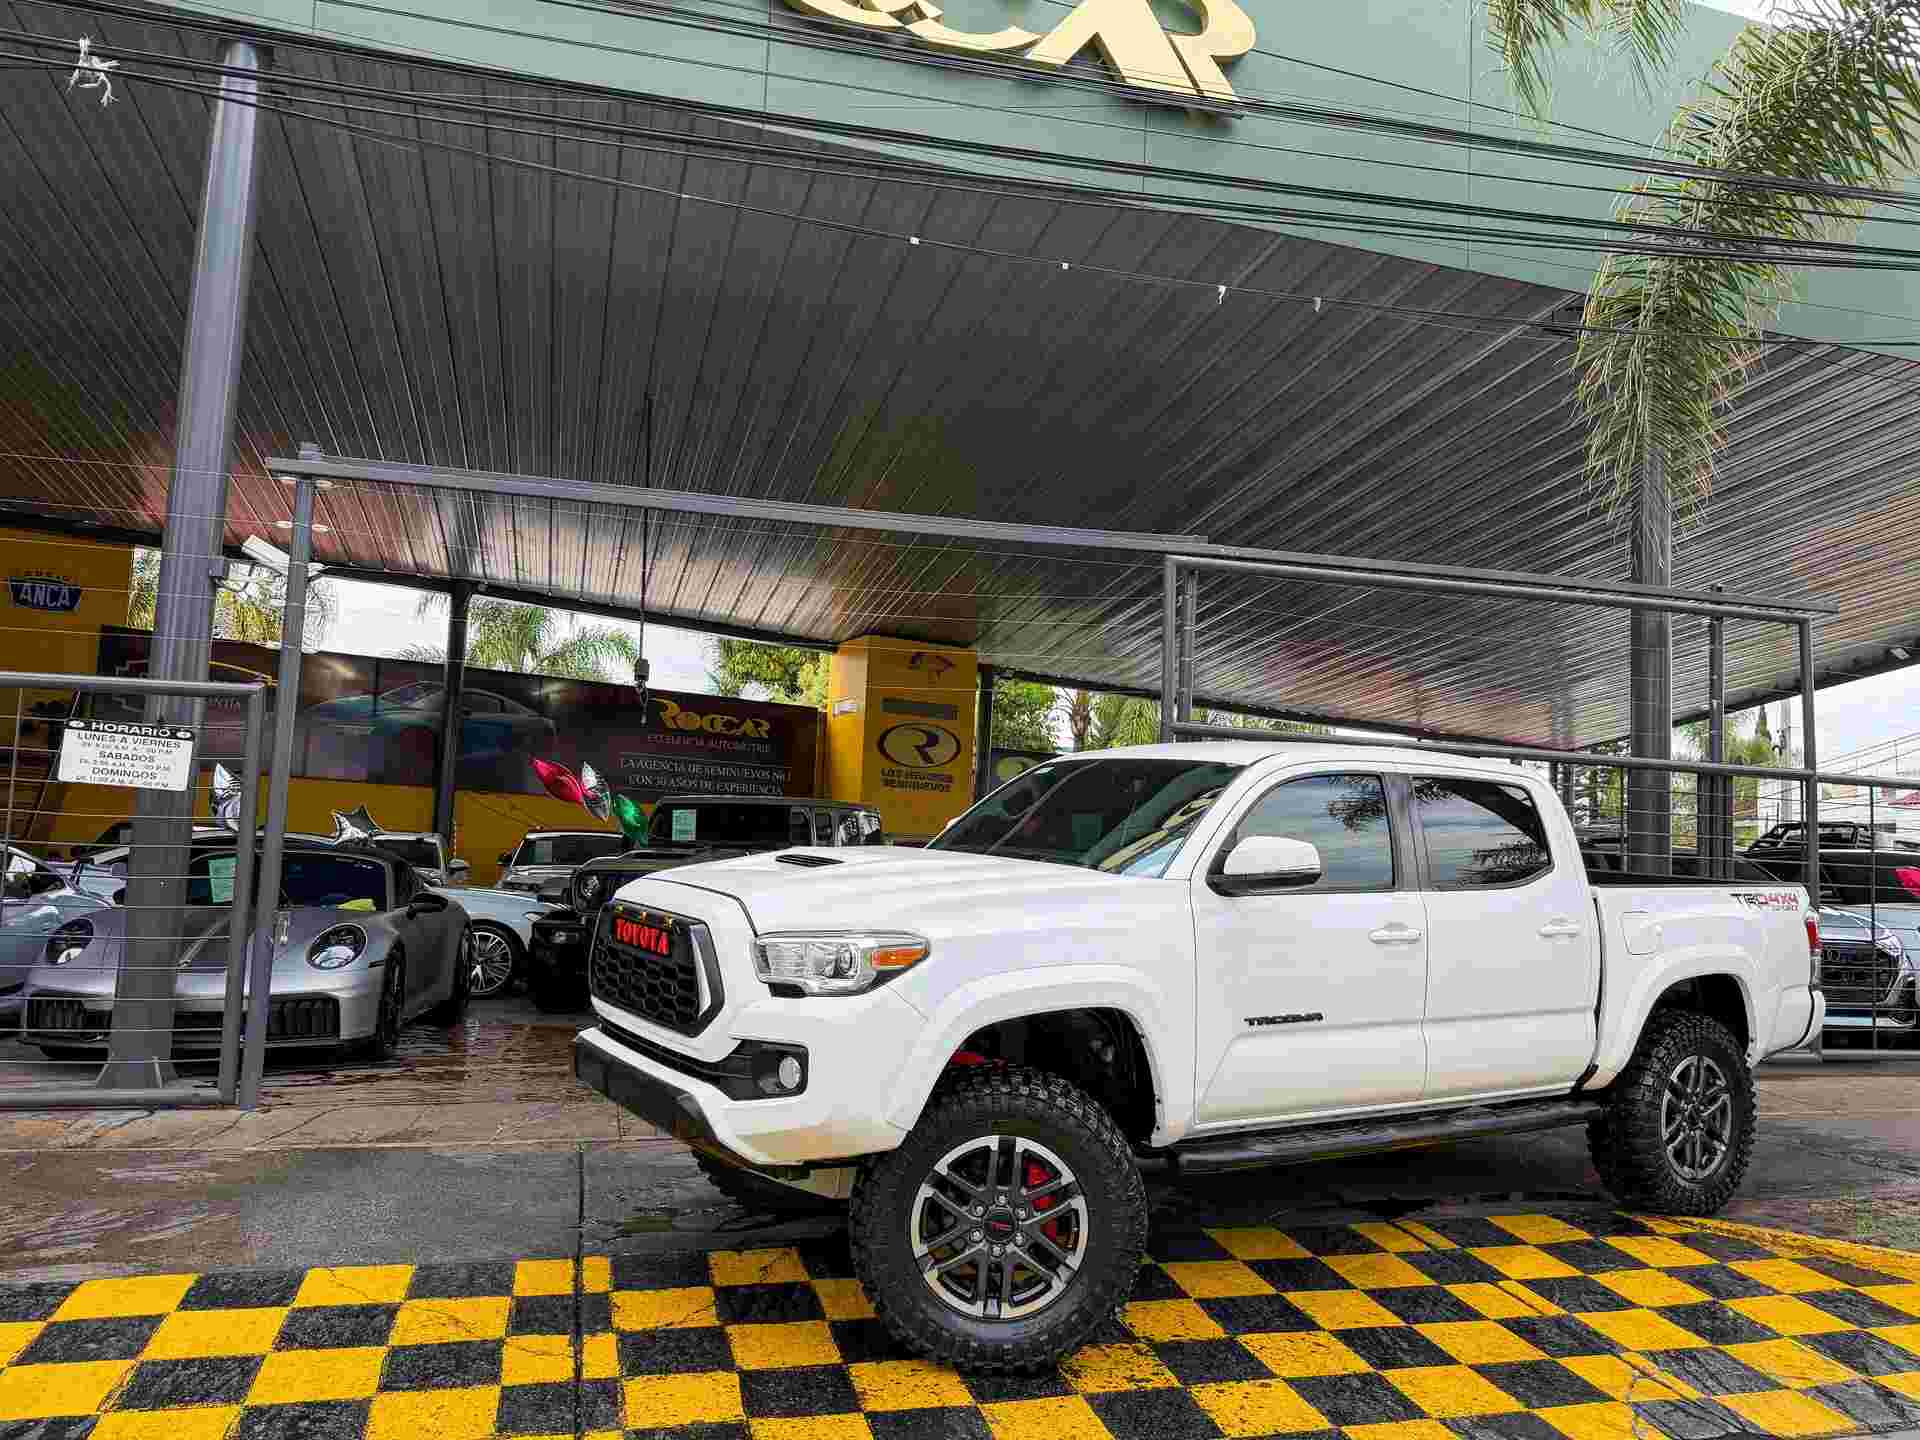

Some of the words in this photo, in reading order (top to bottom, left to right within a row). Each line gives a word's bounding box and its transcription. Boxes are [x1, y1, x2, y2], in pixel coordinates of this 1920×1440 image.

[91, 722, 170, 737] HORARIO
[77, 731, 117, 744] LUNES
[120, 736, 128, 744] A
[132, 737, 181, 749] VIERNES
[91, 766, 158, 780] DOMINGOS
[615, 918, 670, 956] TOYOTA
[1243, 1012, 1324, 1026] TACOMA
